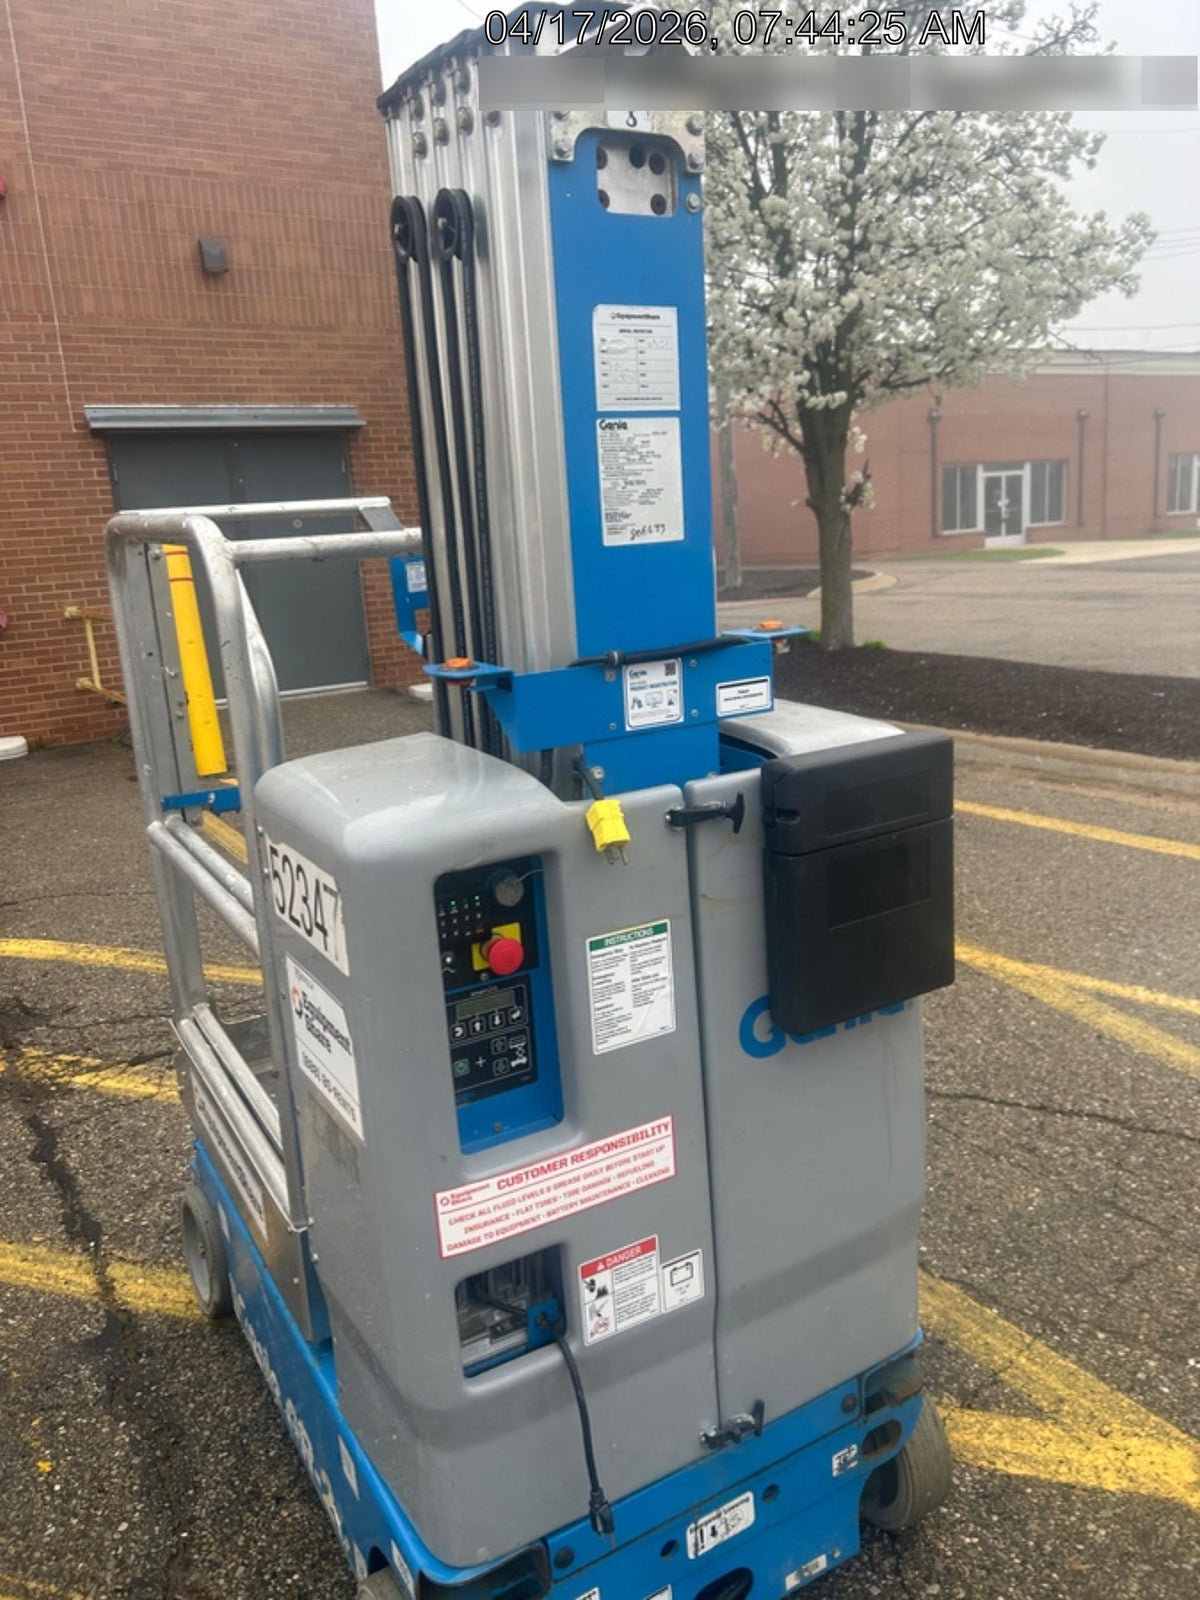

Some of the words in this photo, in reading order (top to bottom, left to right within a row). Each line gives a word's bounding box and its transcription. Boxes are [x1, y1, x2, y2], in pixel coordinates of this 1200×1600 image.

[598, 418, 628, 431] Genie
[269, 844, 340, 962] 52347
[603, 926, 655, 947] INSTRUCTIONS
[448, 1211, 476, 1226] CHECK
[478, 1206, 491, 1216] ALL
[493, 1198, 517, 1212] FLUID
[518, 1188, 544, 1203] LEVELS
[583, 1167, 603, 1180] DAILY
[605, 1158, 631, 1172] BEFORE
[632, 1148, 655, 1161] START
[655, 1143, 666, 1153] UP
[497, 1158, 568, 1190] CUSTOMER
[570, 1121, 670, 1165] RESPONSIBILITY
[447, 1235, 482, 1251] DAMAGE
[484, 1230, 495, 1240] TO
[496, 1214, 541, 1236] EQUIPMENT
[547, 1201, 578, 1217] BATTERY
[580, 1180, 630, 1205] MAINTENANCE
[636, 1166, 671, 1184] CLEANING
[464, 1213, 510, 1235] INSURANCE
[515, 1204, 533, 1216] FLAT
[535, 1196, 557, 1209] TIRES
[581, 1176, 611, 1192] DAMAGE
[617, 1160, 655, 1179] REFUELING
[605, 1245, 642, 1270] DANGER
